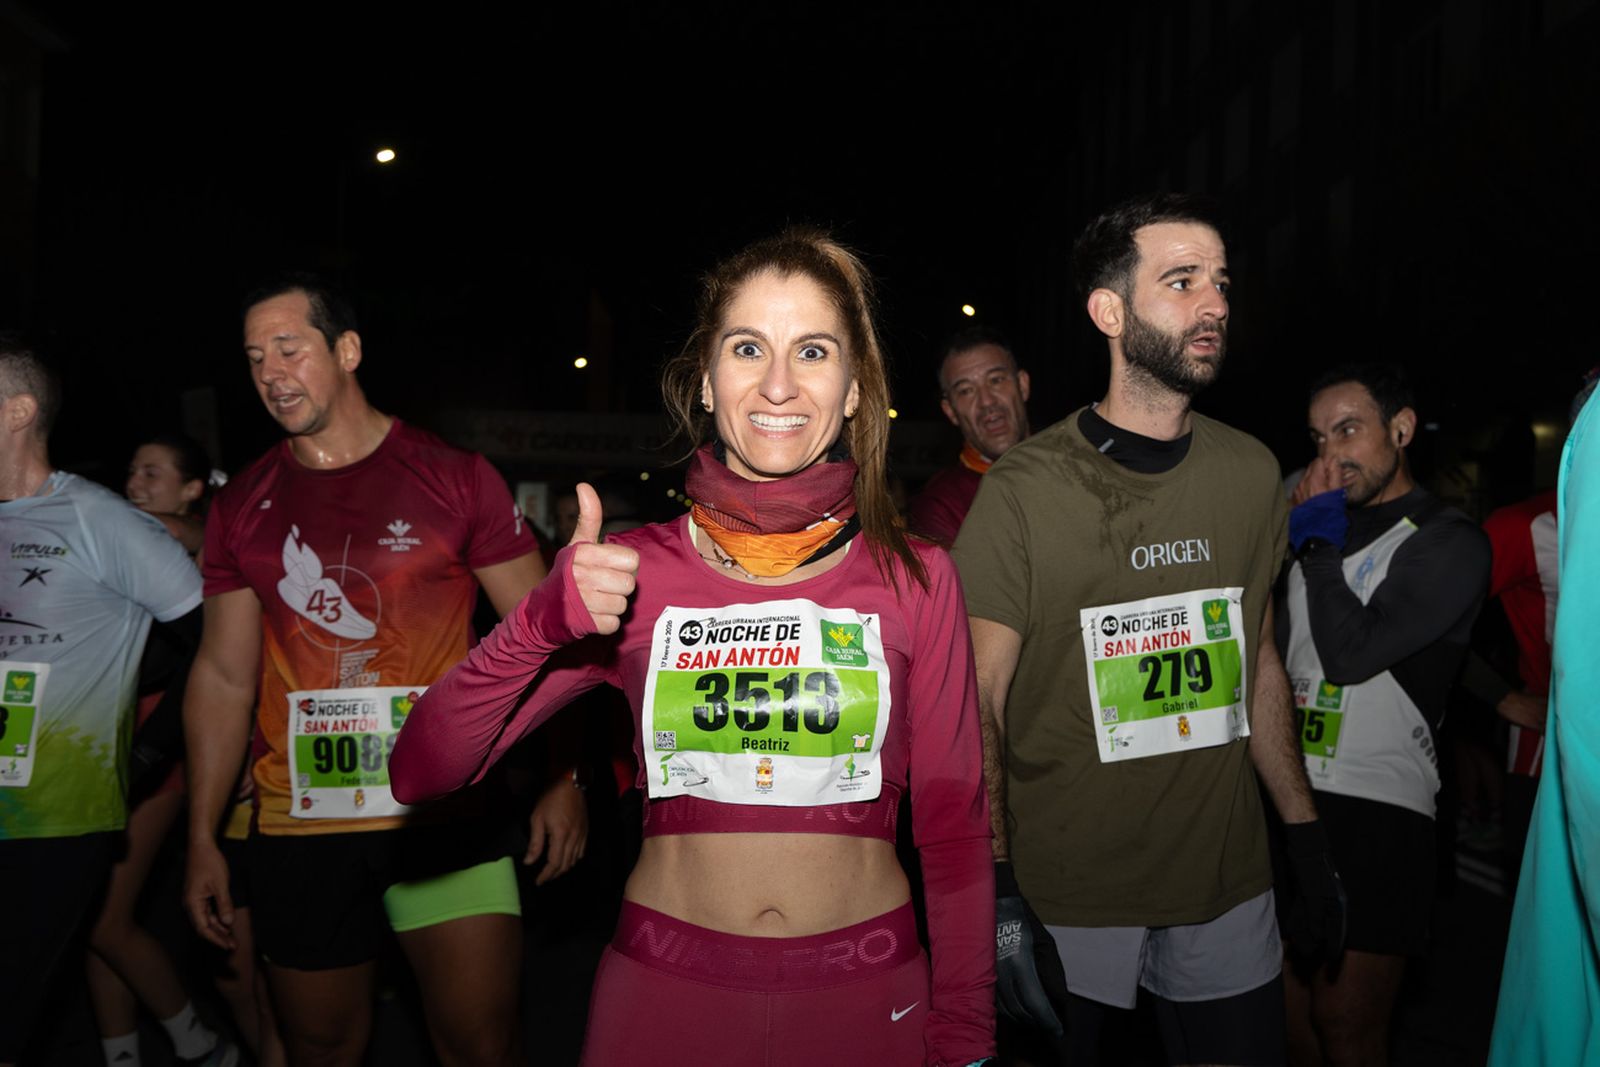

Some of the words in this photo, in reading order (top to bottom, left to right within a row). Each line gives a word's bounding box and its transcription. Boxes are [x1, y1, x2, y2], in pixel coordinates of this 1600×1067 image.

[1131, 539, 1210, 570] ORIGEN
[306, 590, 342, 623] 43
[732, 617, 756, 625] URBANA
[756, 615, 801, 624] INTERNACIONAL
[1101, 619, 1119, 631] 43
[1121, 614, 1168, 635] NOCHE
[1171, 611, 1189, 627] DE
[680, 626, 702, 641] 43
[705, 625, 772, 645] NOCHE
[775, 623, 802, 641] DE
[1104, 638, 1137, 658] SAN
[1141, 627, 1192, 653] ANTÓN
[676, 649, 721, 670] SAN
[723, 642, 801, 667] ANTÓN
[1138, 647, 1213, 702] 279
[317, 703, 360, 716] NOCHE
[361, 702, 378, 715] DE
[693, 671, 841, 735] 3513
[1162, 698, 1199, 714] Gabriel
[304, 720, 329, 734] SAN
[332, 715, 379, 733] ANTÓN
[741, 736, 790, 752] Beatriz
[782, 927, 898, 975] PRO
